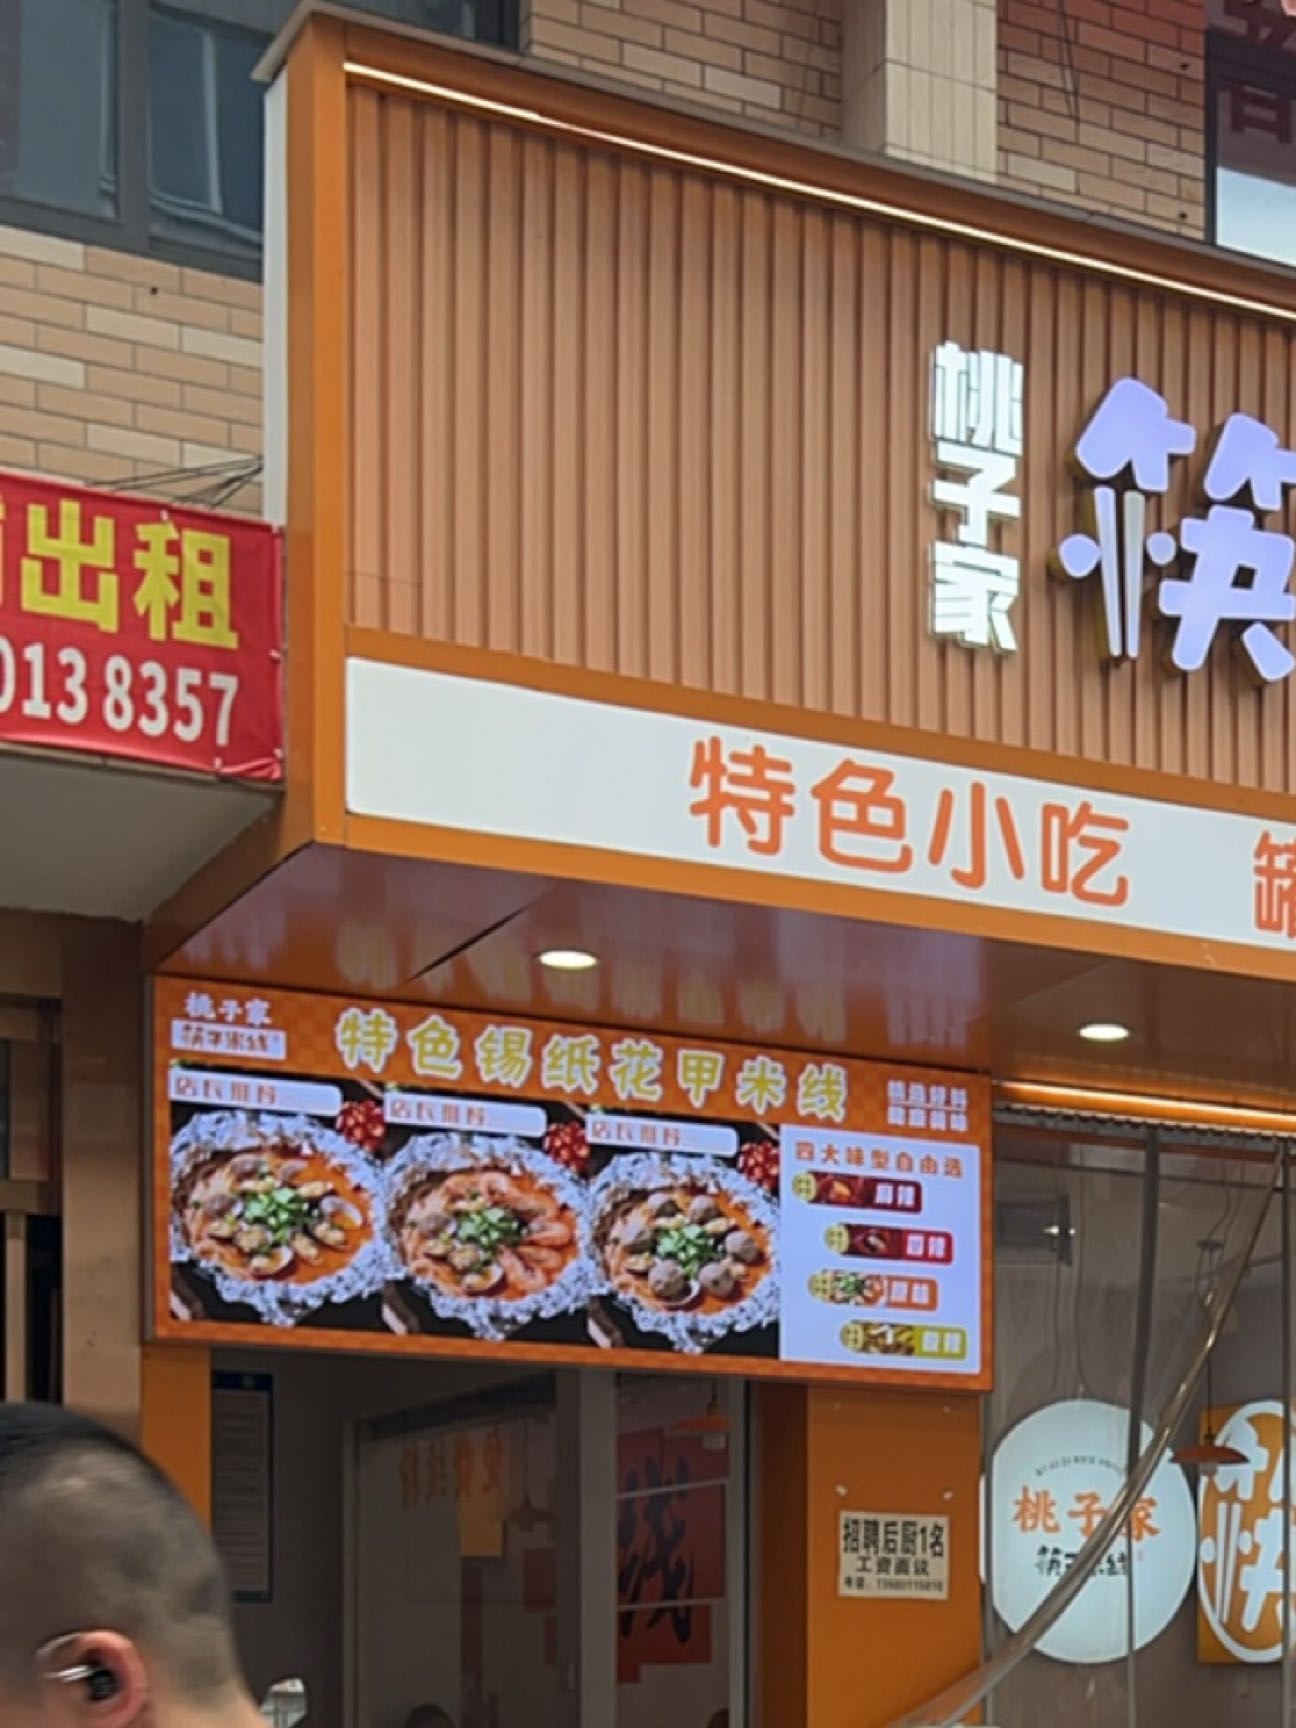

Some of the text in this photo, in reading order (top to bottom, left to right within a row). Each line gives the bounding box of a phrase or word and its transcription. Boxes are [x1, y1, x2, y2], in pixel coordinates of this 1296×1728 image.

[0, 495, 239, 650] 出租
[933, 340, 1023, 651] 桃子家
[103, 654, 239, 748] 8357
[689, 736, 1130, 907] 特色小吃
[336, 1006, 849, 1123] 特色锡纸花甲米线
